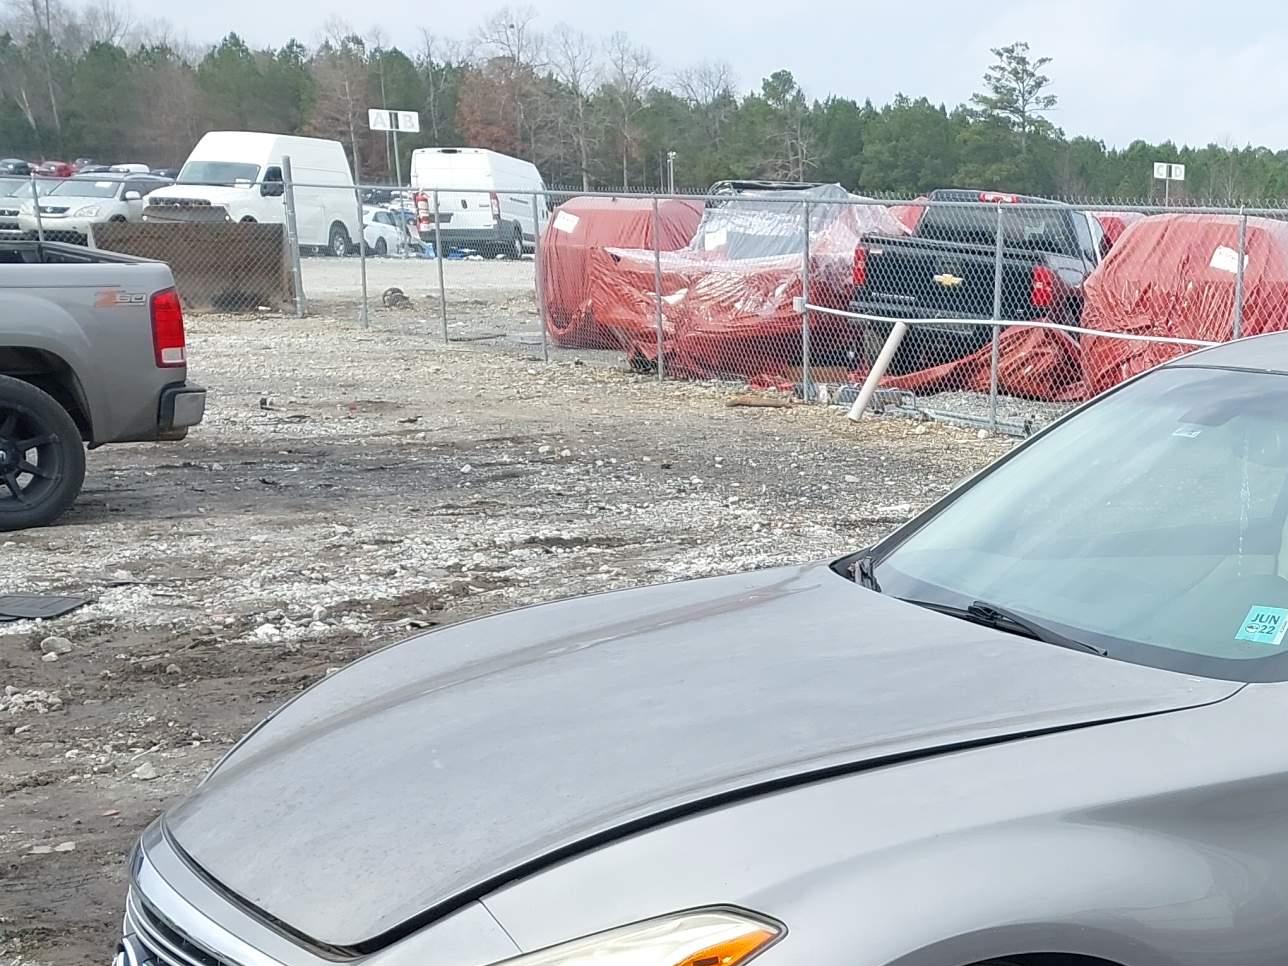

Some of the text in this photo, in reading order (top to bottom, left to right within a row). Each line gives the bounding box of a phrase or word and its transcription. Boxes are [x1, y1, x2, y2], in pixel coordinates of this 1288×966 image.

[372, 111, 415, 129] A B
[1250, 613, 1281, 625] JUN
